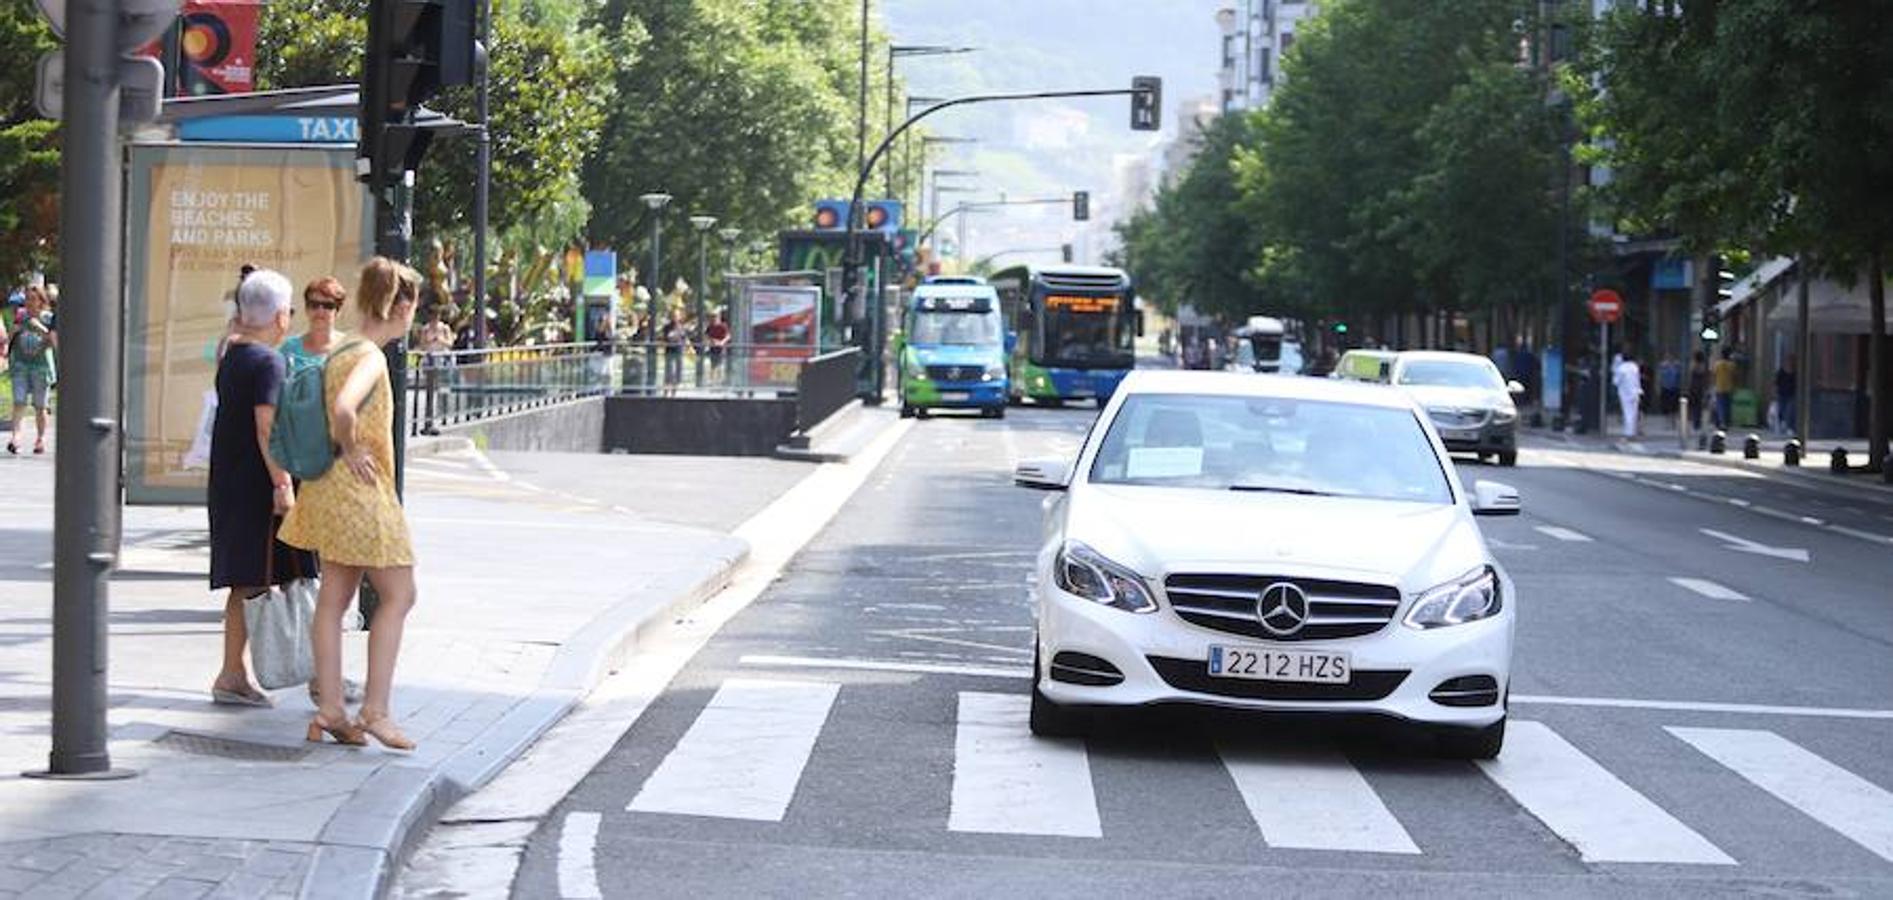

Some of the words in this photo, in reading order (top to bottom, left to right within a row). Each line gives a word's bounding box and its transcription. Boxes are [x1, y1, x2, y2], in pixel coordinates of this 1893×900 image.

[299, 117, 359, 140] TAXI
[171, 190, 229, 208] ENJOY
[233, 192, 270, 210] THE
[171, 209, 255, 228] BEACHES
[171, 228, 208, 244] AND
[213, 229, 273, 246] PARKS
[1227, 651, 1290, 677] 2212
[1299, 655, 1345, 679] HZS
